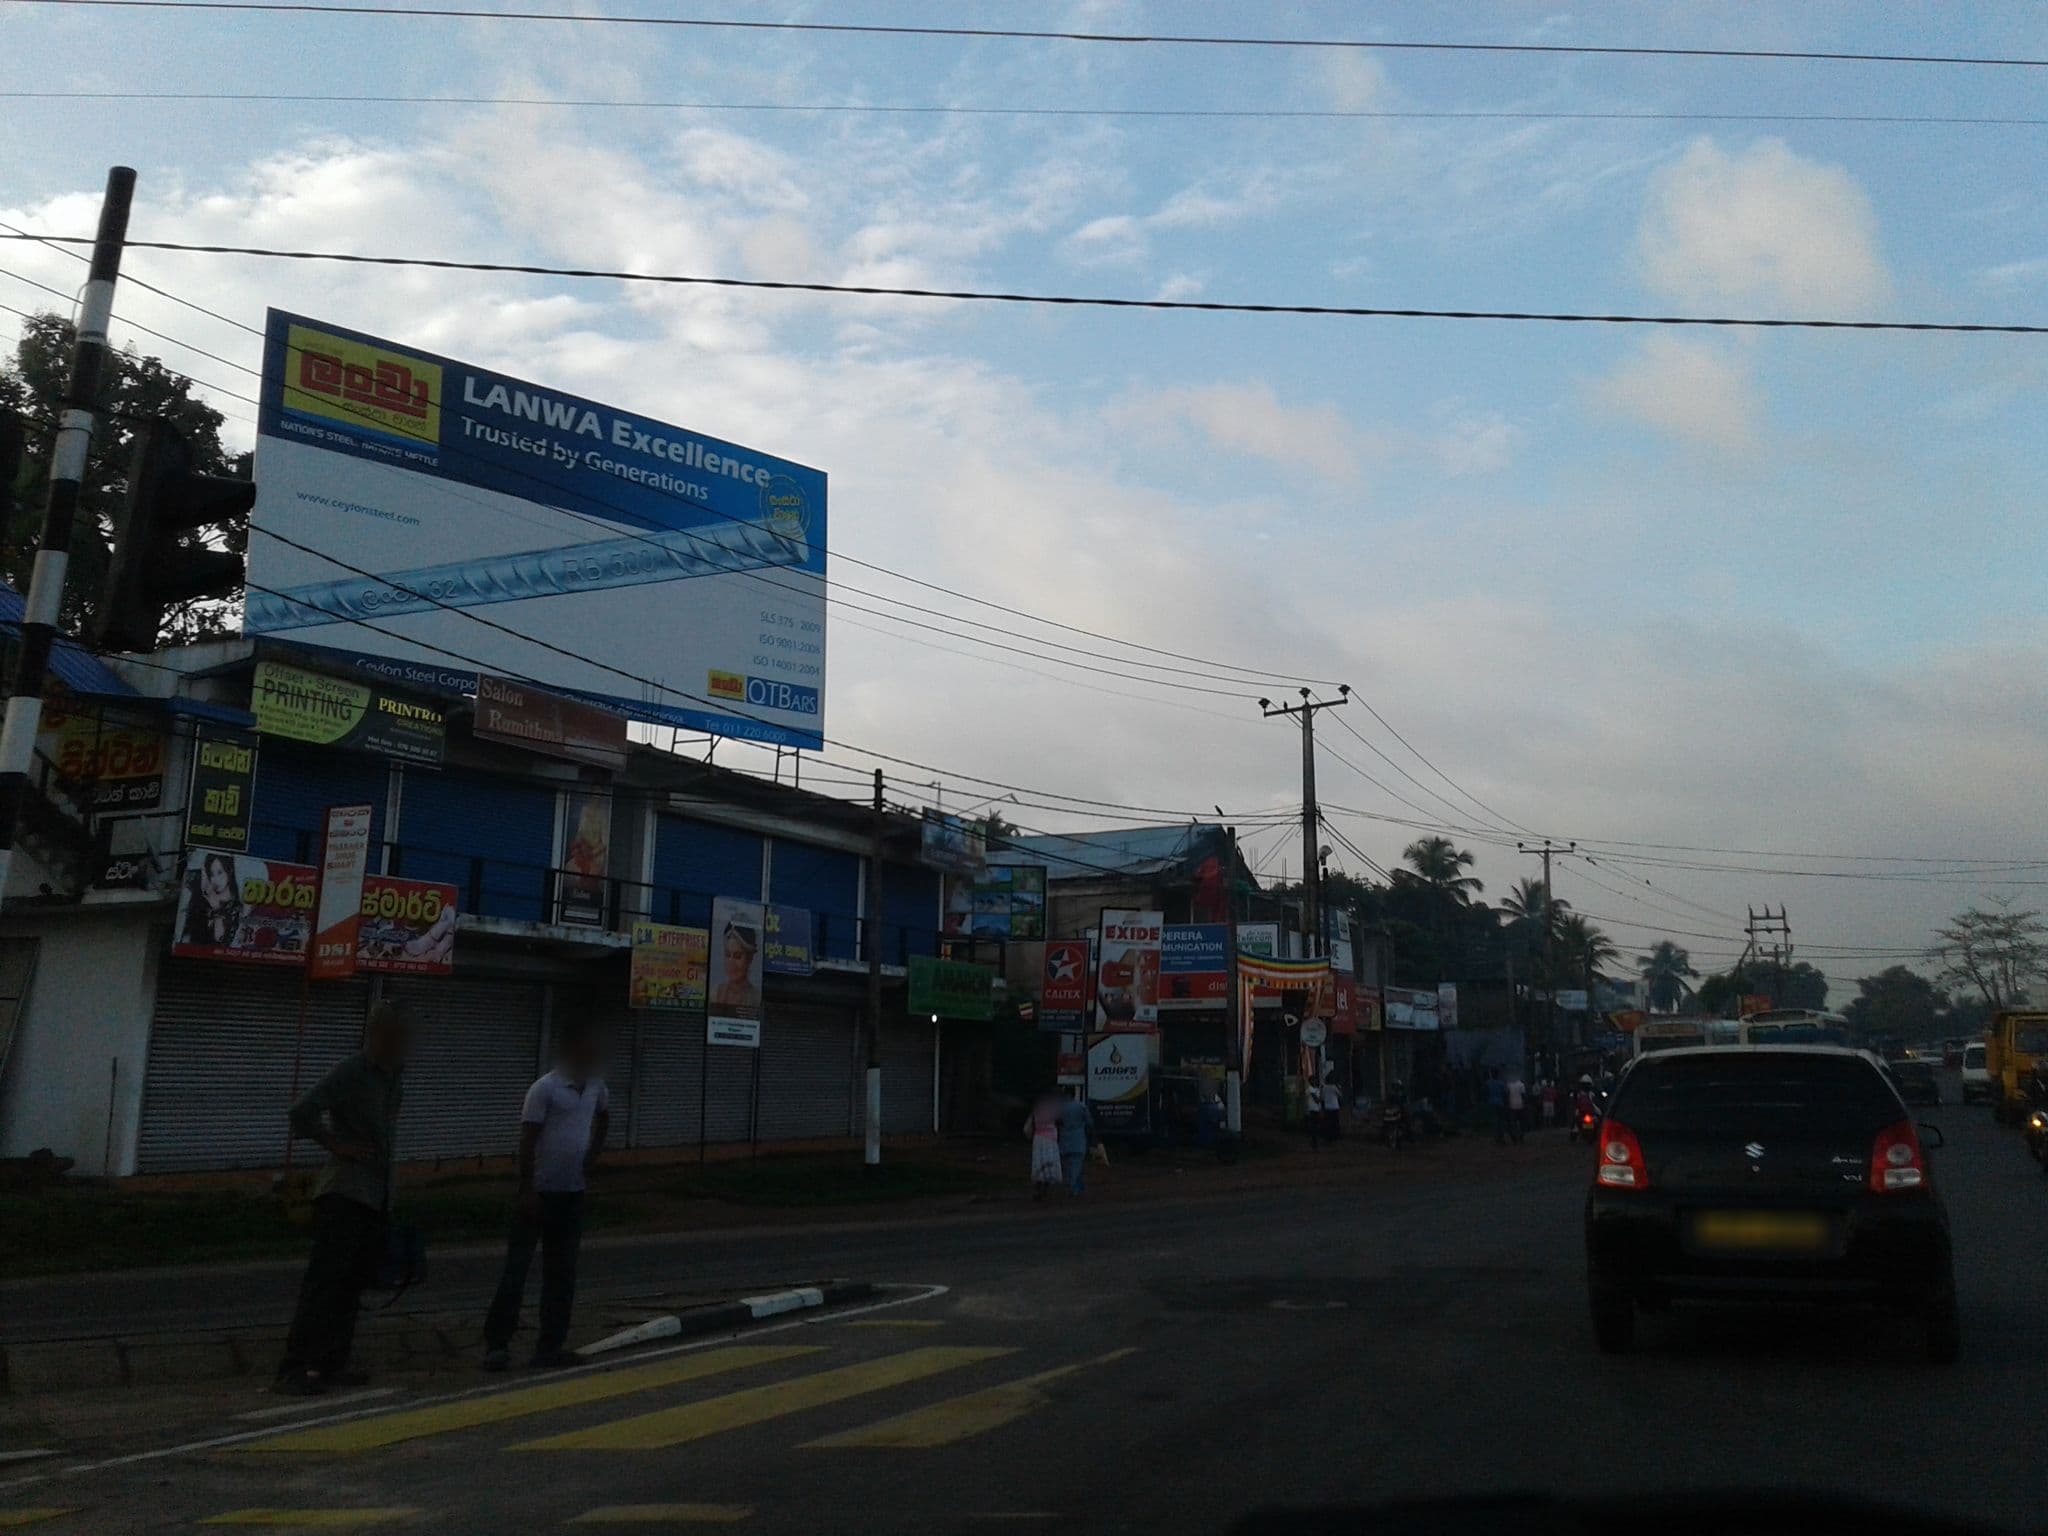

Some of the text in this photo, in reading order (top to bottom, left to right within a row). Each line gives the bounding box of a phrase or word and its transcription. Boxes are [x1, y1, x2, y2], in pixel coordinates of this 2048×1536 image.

[463, 376, 603, 440] LANWA
[611, 420, 769, 488] Excellence
[460, 416, 547, 456] Trusted
[552, 442, 579, 470] by
[585, 451, 709, 501] Generations
[297, 491, 420, 526] www.ceylonsteel.com
[406, 666, 436, 683] Steel
[753, 655, 769, 667] ISO
[264, 663, 360, 698] Offset Screen
[482, 677, 524, 707] Salon
[262, 678, 352, 720] PRINTING
[1105, 925, 1160, 941] EXIDE
[1045, 988, 1080, 998] CALTEX
[1094, 1066, 1138, 1075] LAUGFS
